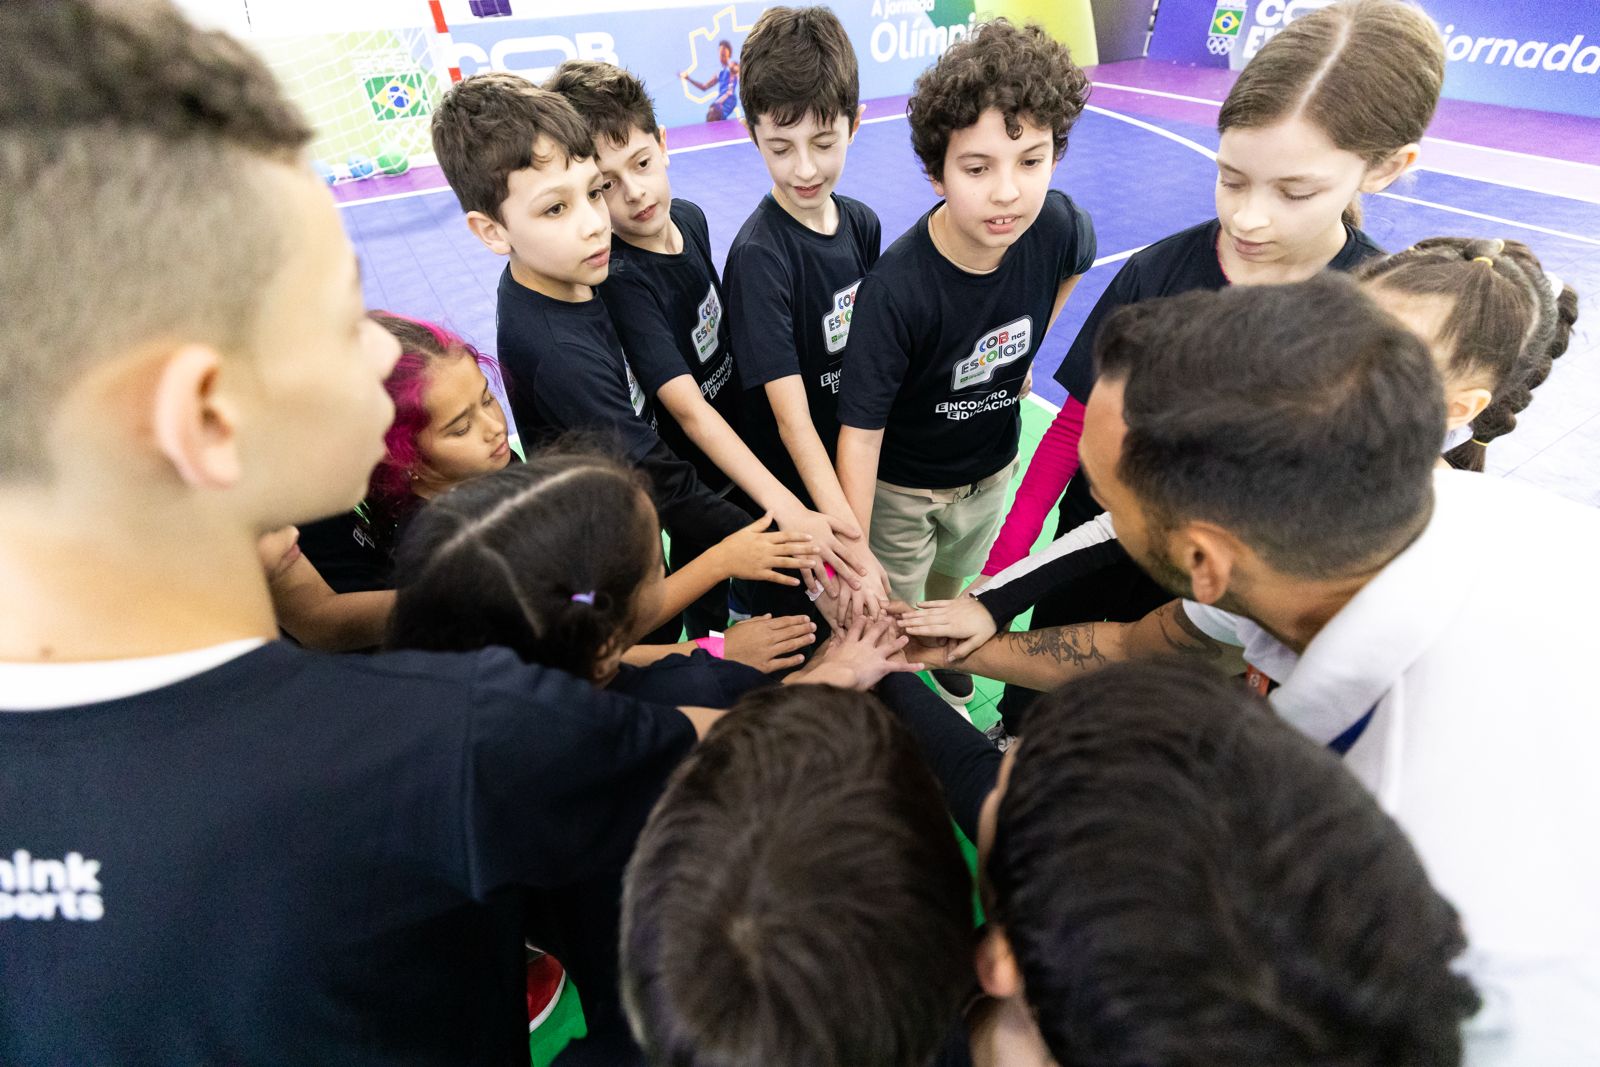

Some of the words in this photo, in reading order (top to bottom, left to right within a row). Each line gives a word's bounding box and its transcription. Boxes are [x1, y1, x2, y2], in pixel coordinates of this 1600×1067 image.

[870, 12, 977, 62] Olímpi
[828, 309, 853, 332] ESCO
[979, 330, 1010, 353] COB
[1011, 330, 1027, 341] nas
[935, 389, 1008, 414] ENCONTRO
[946, 394, 1020, 421] EDUCACION
[0, 889, 105, 921] ports
